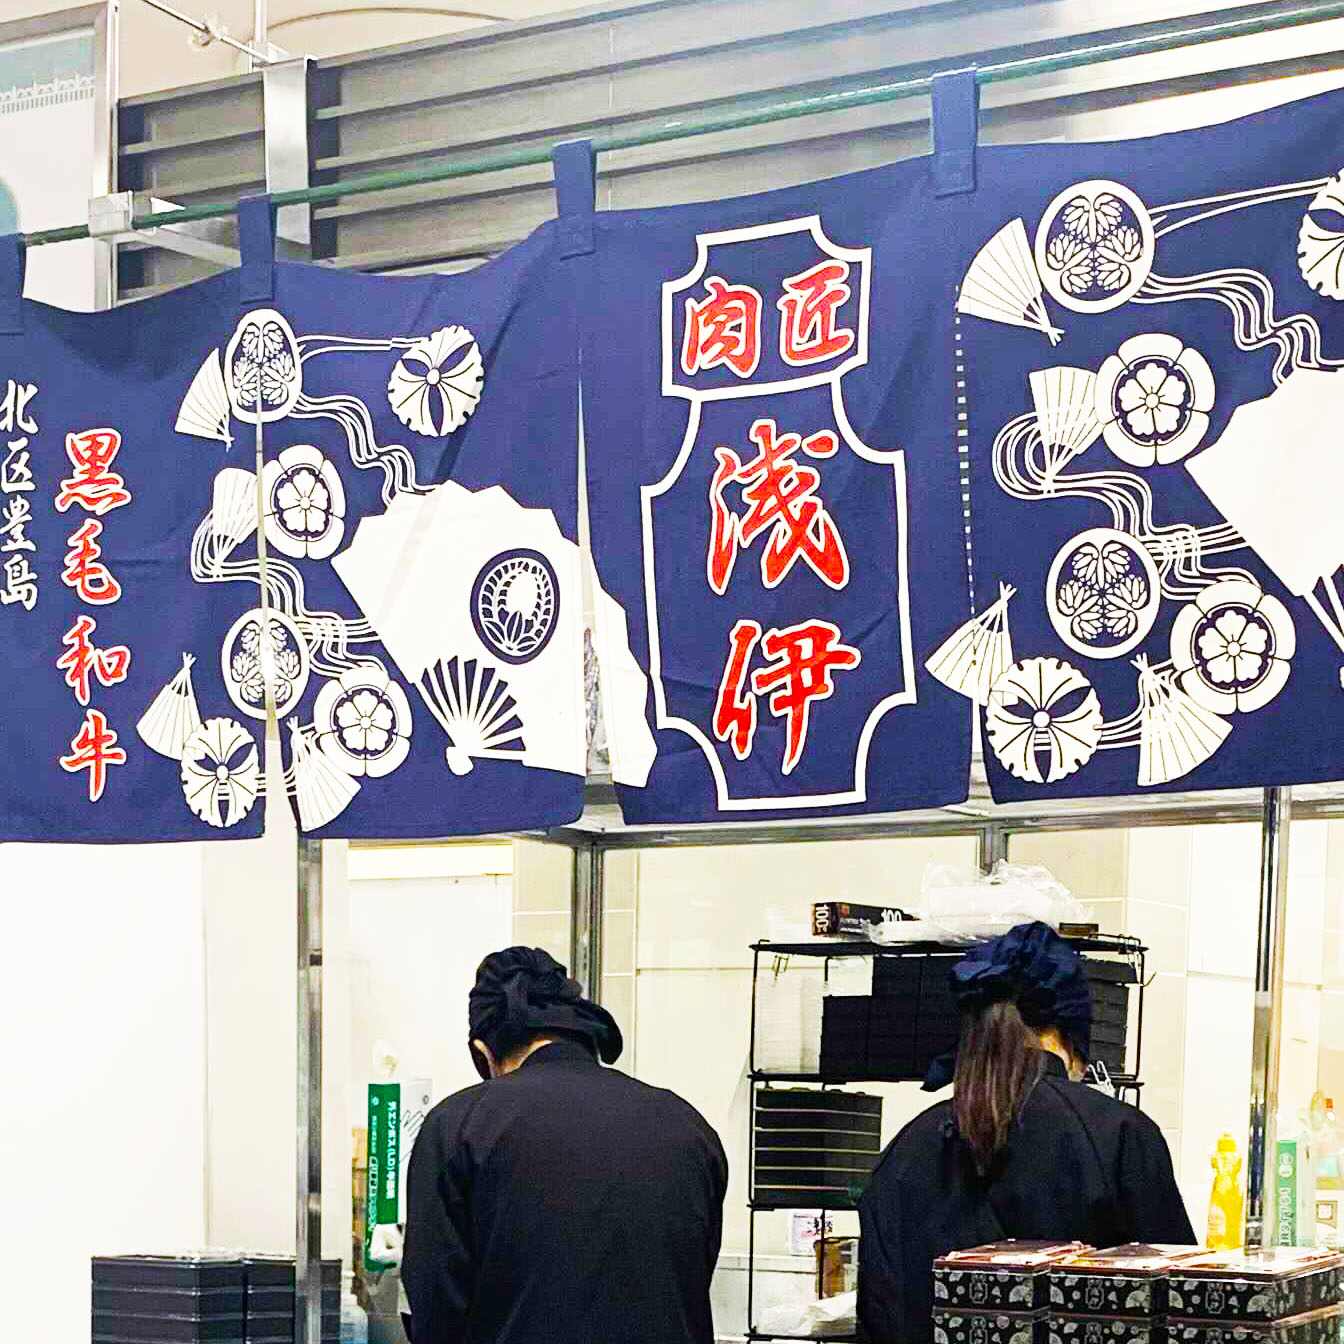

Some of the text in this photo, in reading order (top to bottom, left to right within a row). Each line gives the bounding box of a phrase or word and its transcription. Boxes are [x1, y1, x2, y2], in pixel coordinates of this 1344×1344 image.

[680, 259, 854, 378] 肉匠
[55, 427, 131, 802] 黒毛和牛
[707, 419, 861, 775] 浅伊
